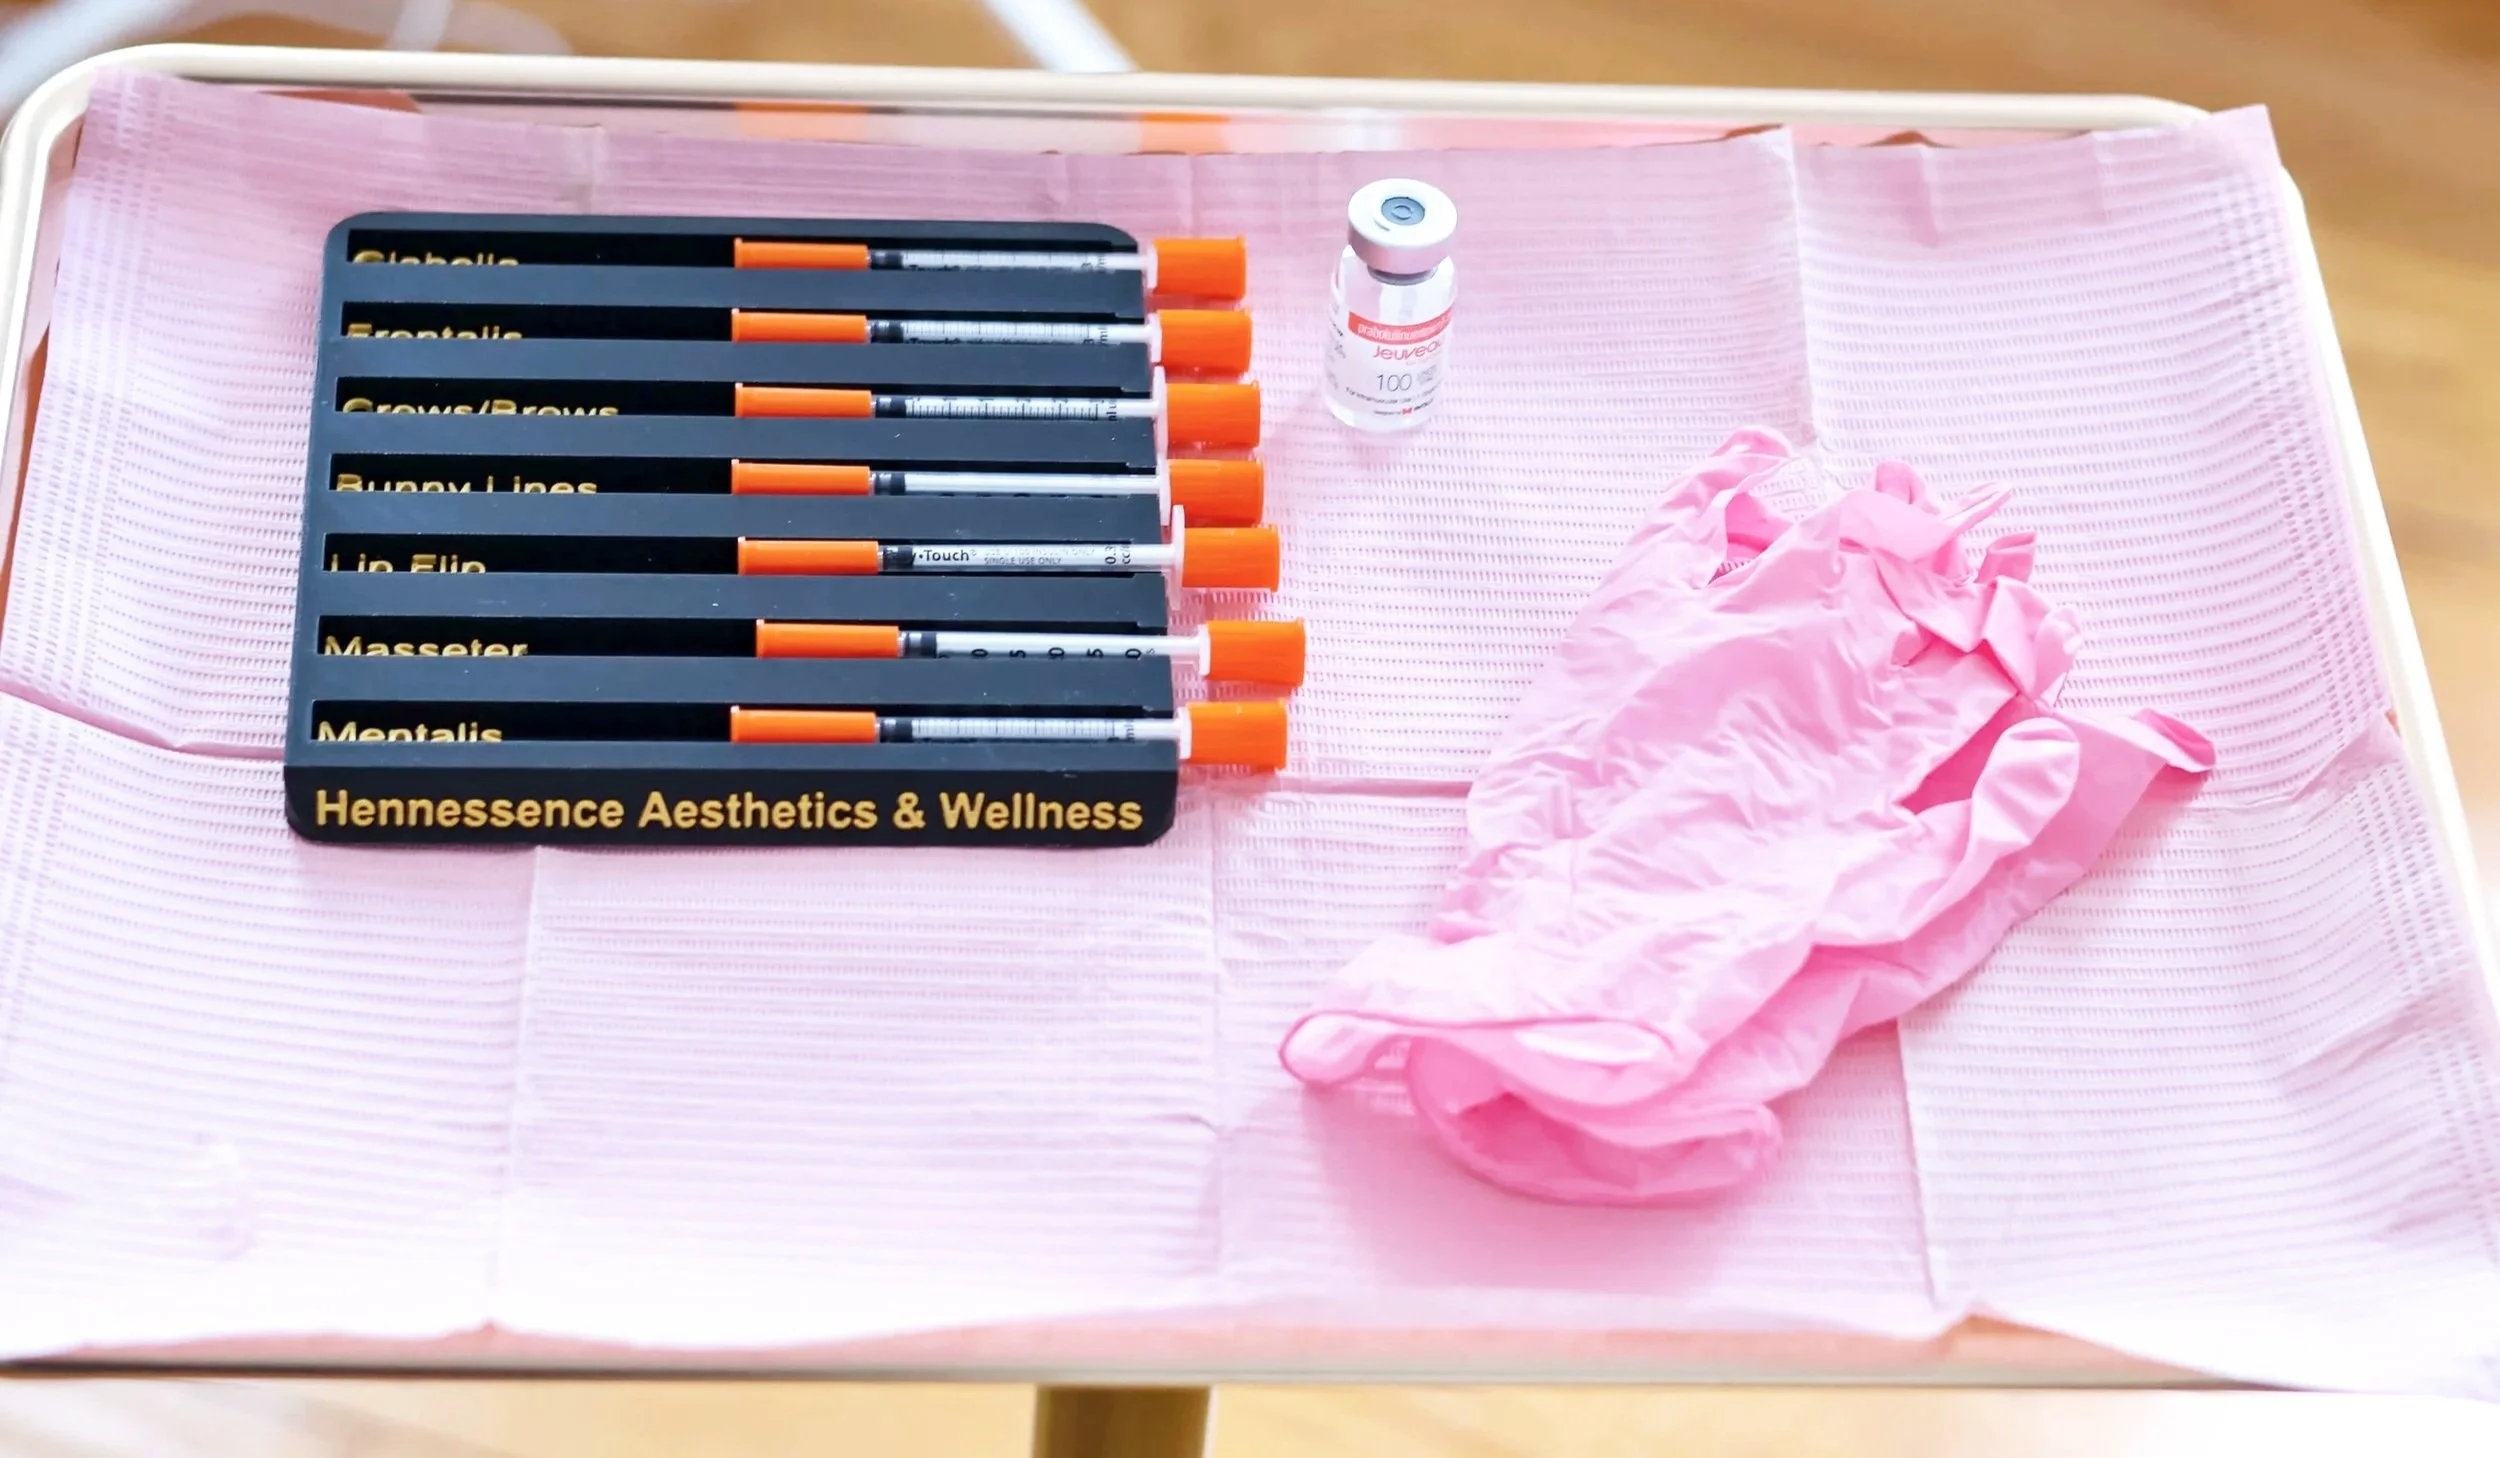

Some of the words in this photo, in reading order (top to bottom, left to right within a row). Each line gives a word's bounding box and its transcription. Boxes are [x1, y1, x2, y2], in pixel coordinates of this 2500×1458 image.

[1373, 341, 1443, 361] Jeuvea
[1376, 373, 1413, 392] 100
[316, 789, 624, 828] Hennessence
[638, 790, 878, 829] Aesthetics
[893, 791, 926, 829] &
[939, 792, 1143, 831] Wellness
